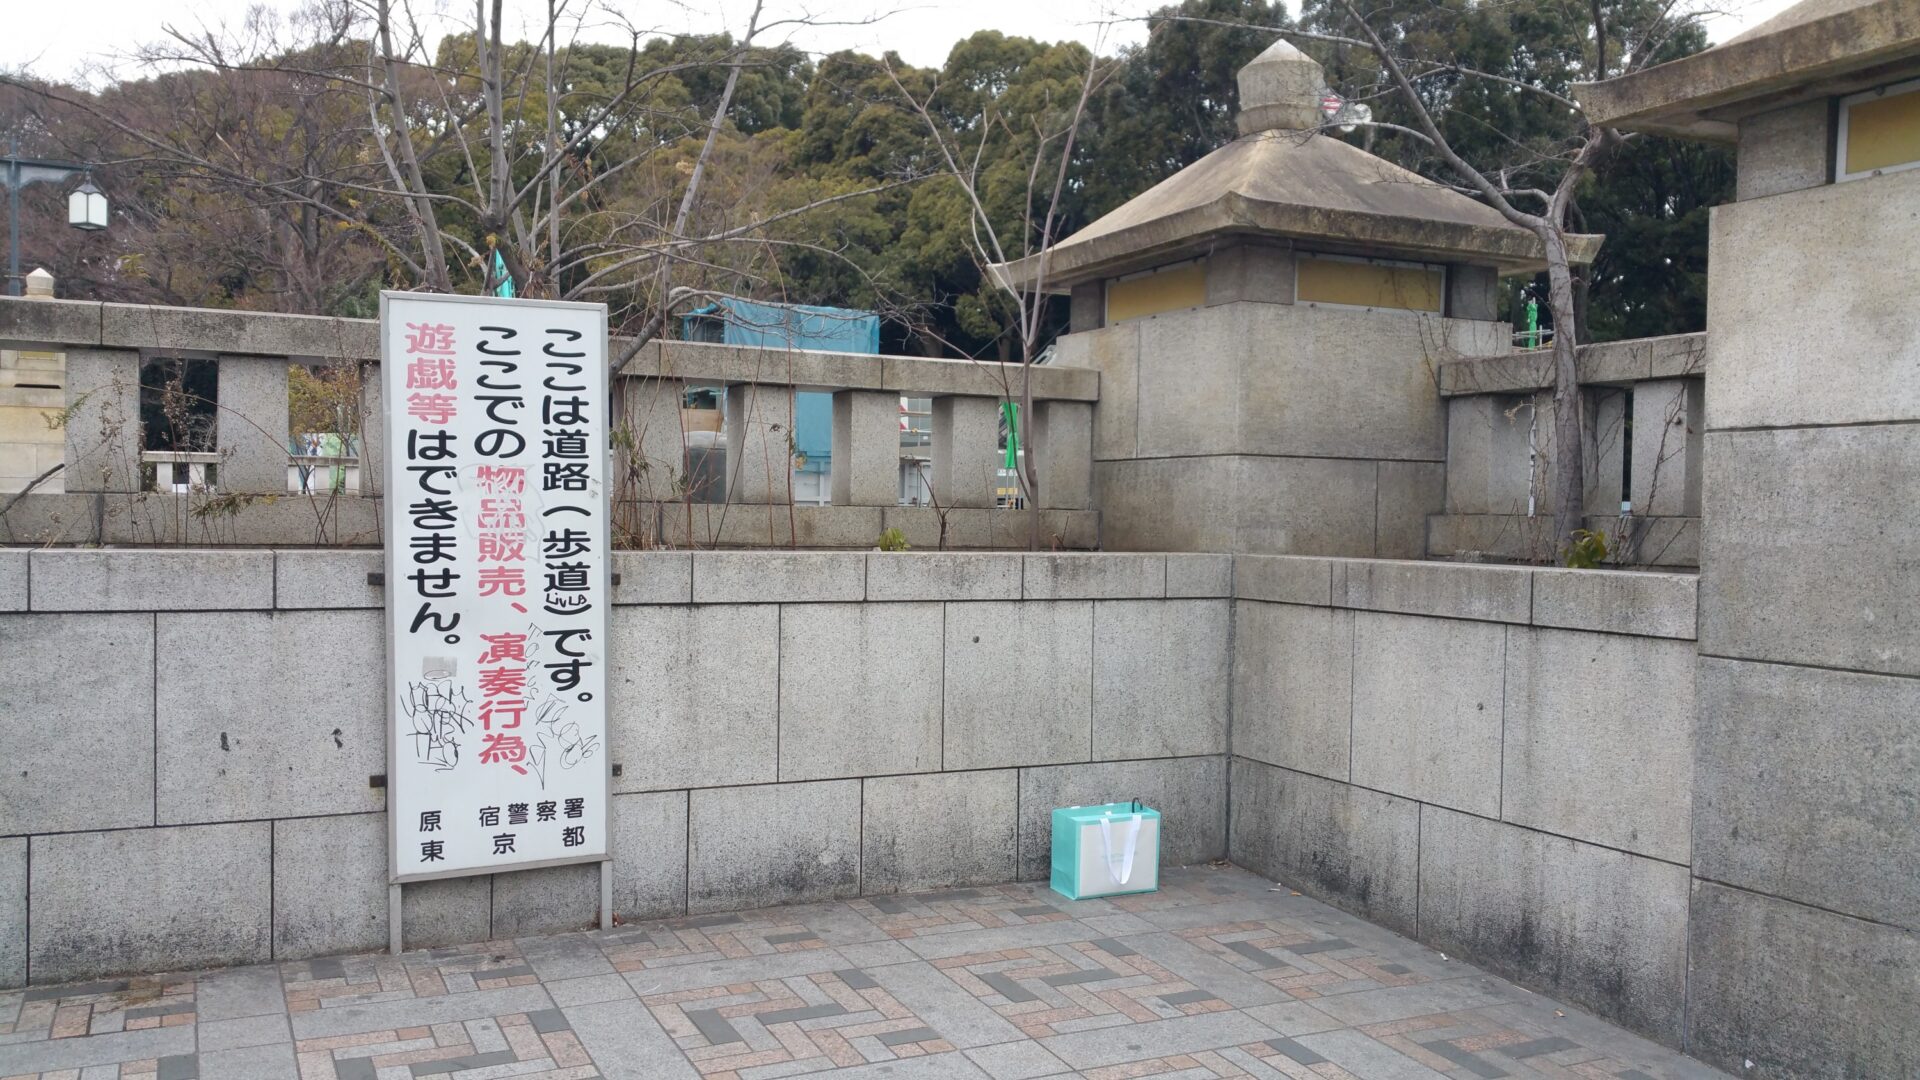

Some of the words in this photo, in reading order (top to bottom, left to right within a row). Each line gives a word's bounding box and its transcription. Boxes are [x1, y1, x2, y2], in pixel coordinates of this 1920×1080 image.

[406, 321, 461, 645] 遊戯等はできません。
[420, 825, 585, 863] 東京都
